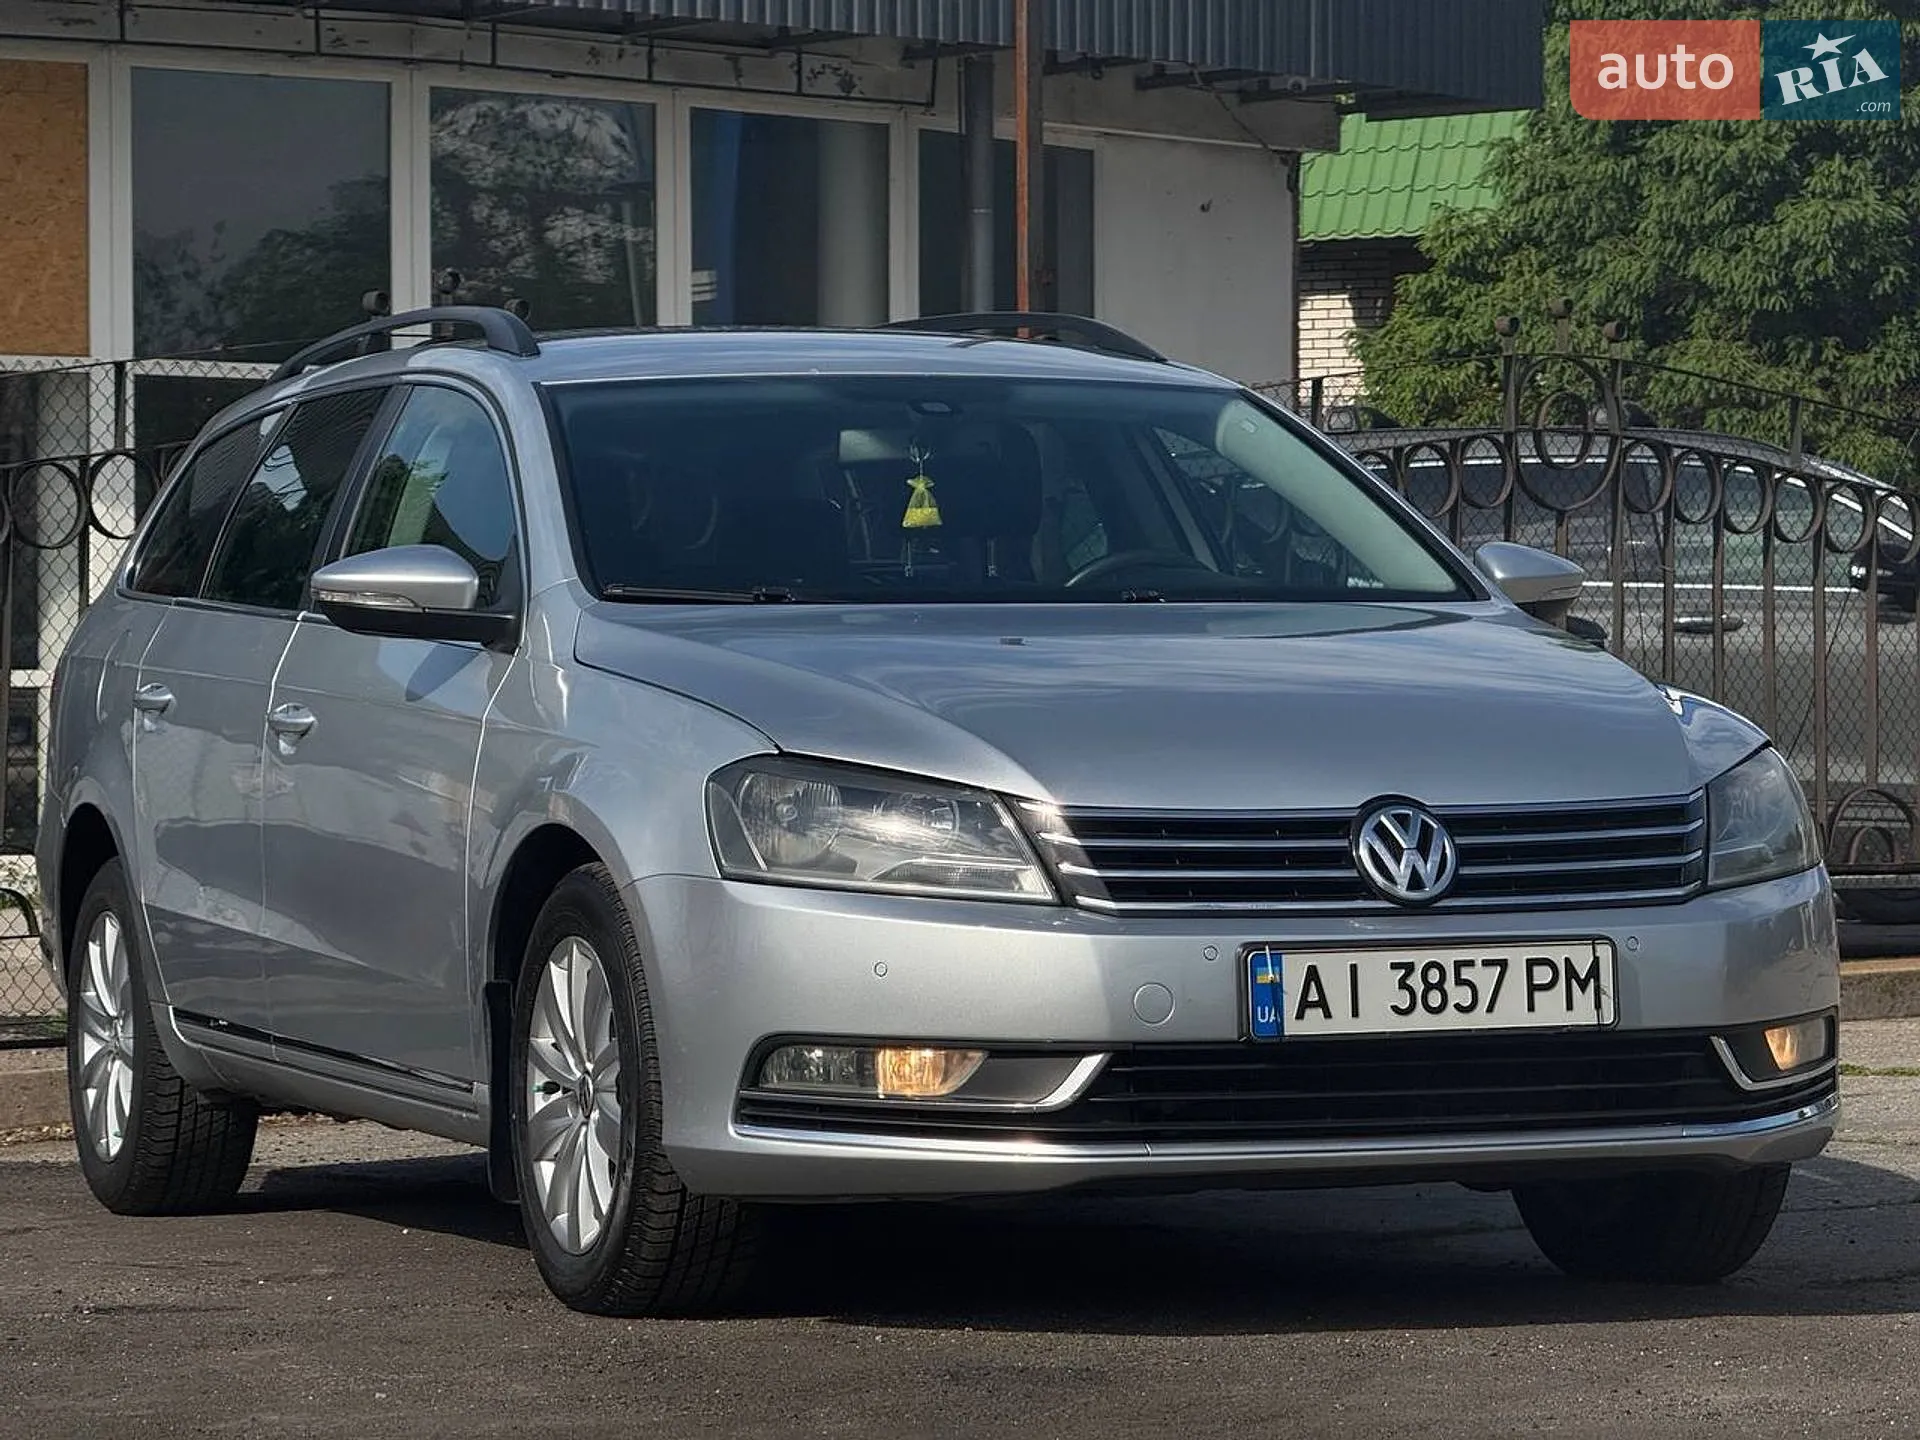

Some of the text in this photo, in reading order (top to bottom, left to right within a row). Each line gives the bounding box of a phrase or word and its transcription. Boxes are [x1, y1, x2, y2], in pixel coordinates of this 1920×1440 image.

[1295, 956, 1601, 1020] AI 3857 PM
